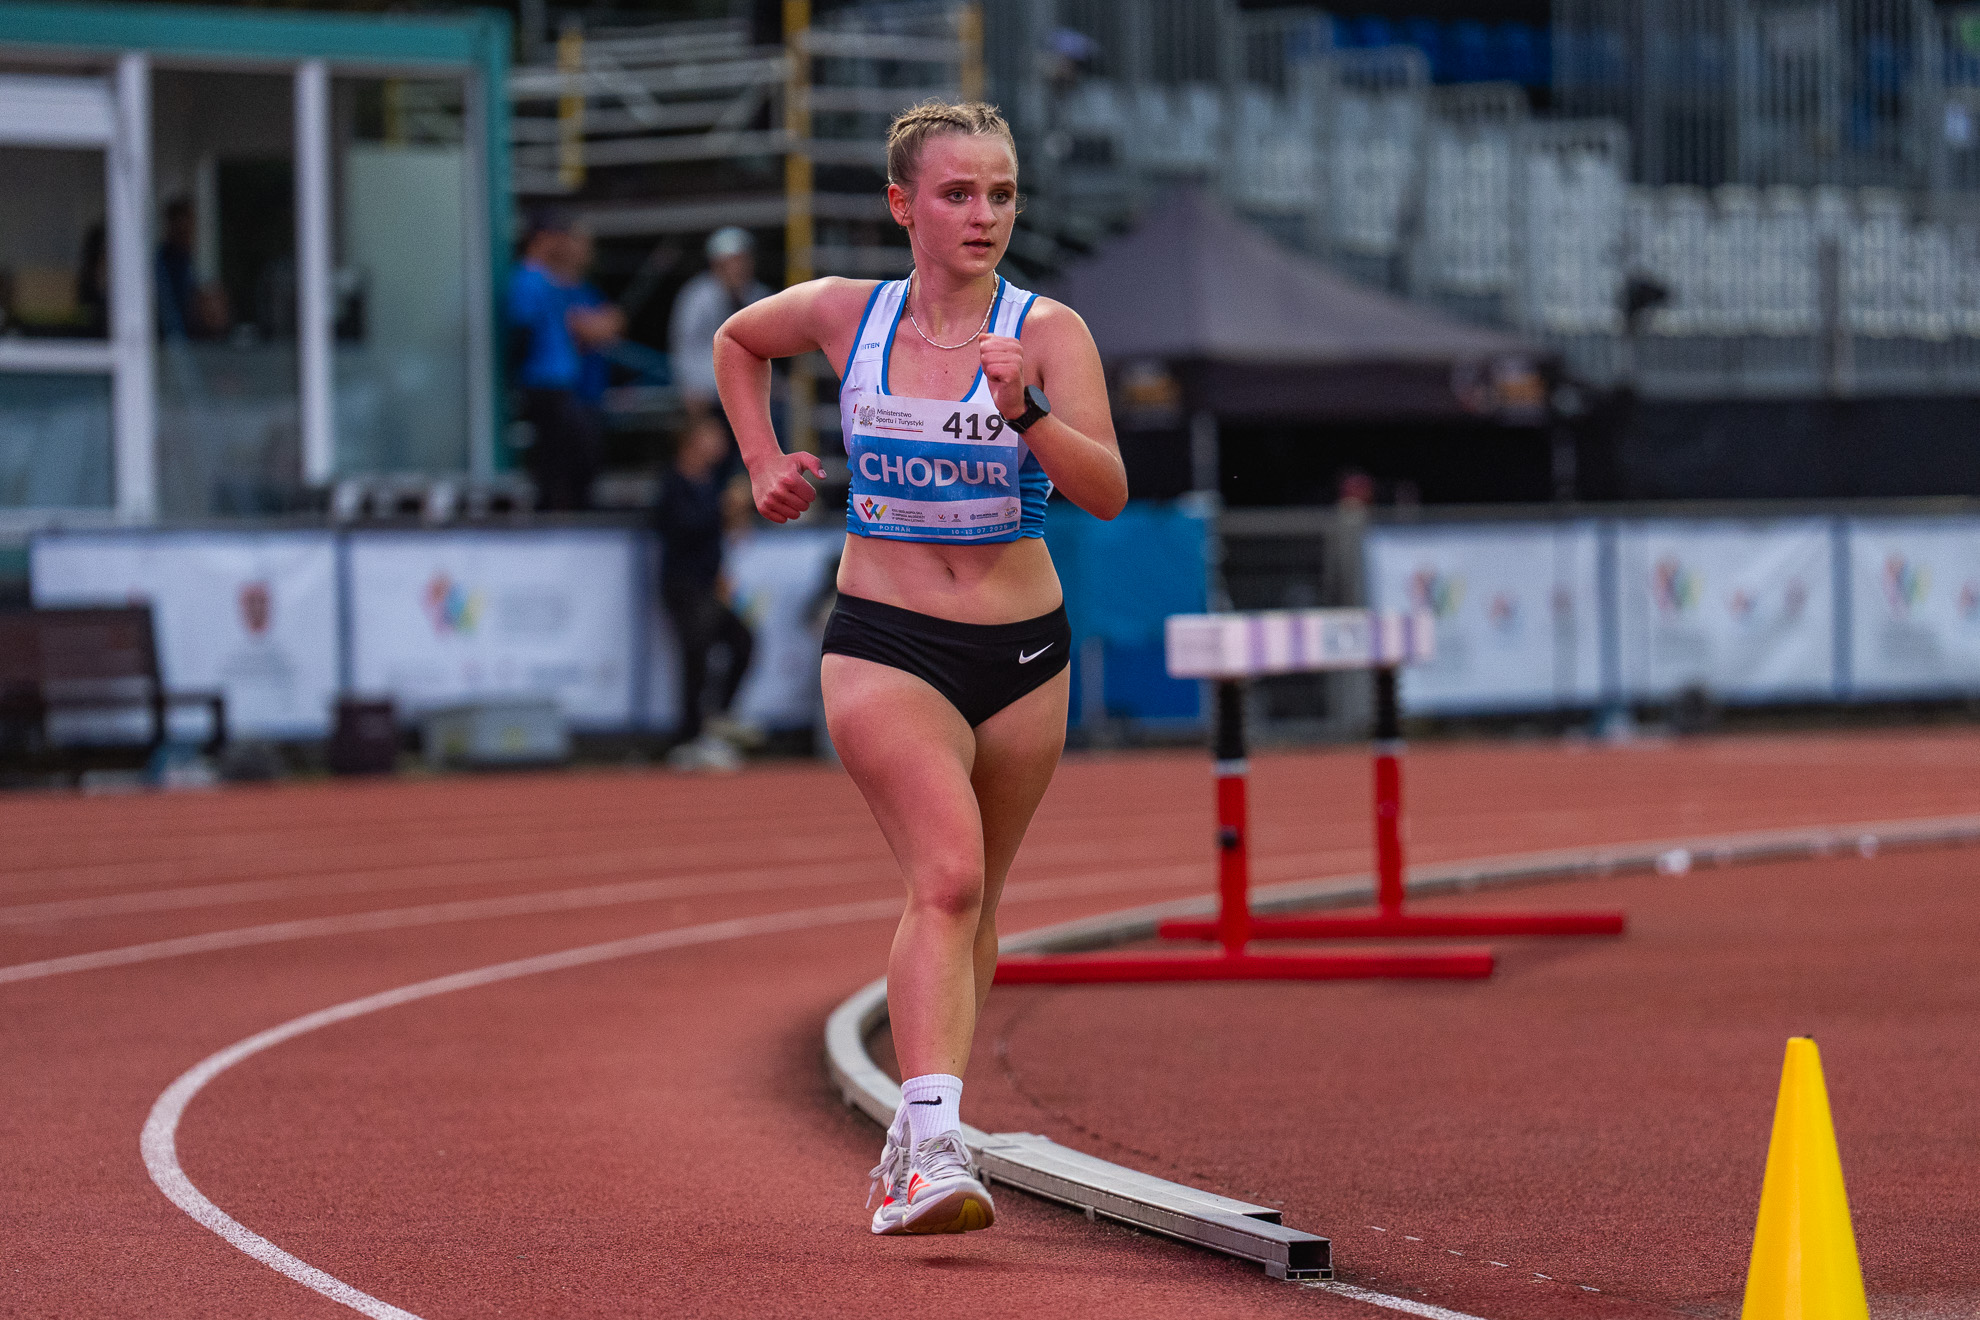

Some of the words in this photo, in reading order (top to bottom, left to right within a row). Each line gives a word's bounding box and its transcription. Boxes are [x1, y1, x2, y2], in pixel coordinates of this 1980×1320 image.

[875, 415, 893, 425] Sportu
[898, 418, 924, 427] Turystyki
[876, 408, 912, 418] Ministerstwo
[942, 411, 1004, 441] 419
[859, 452, 1011, 488] CHODUR
